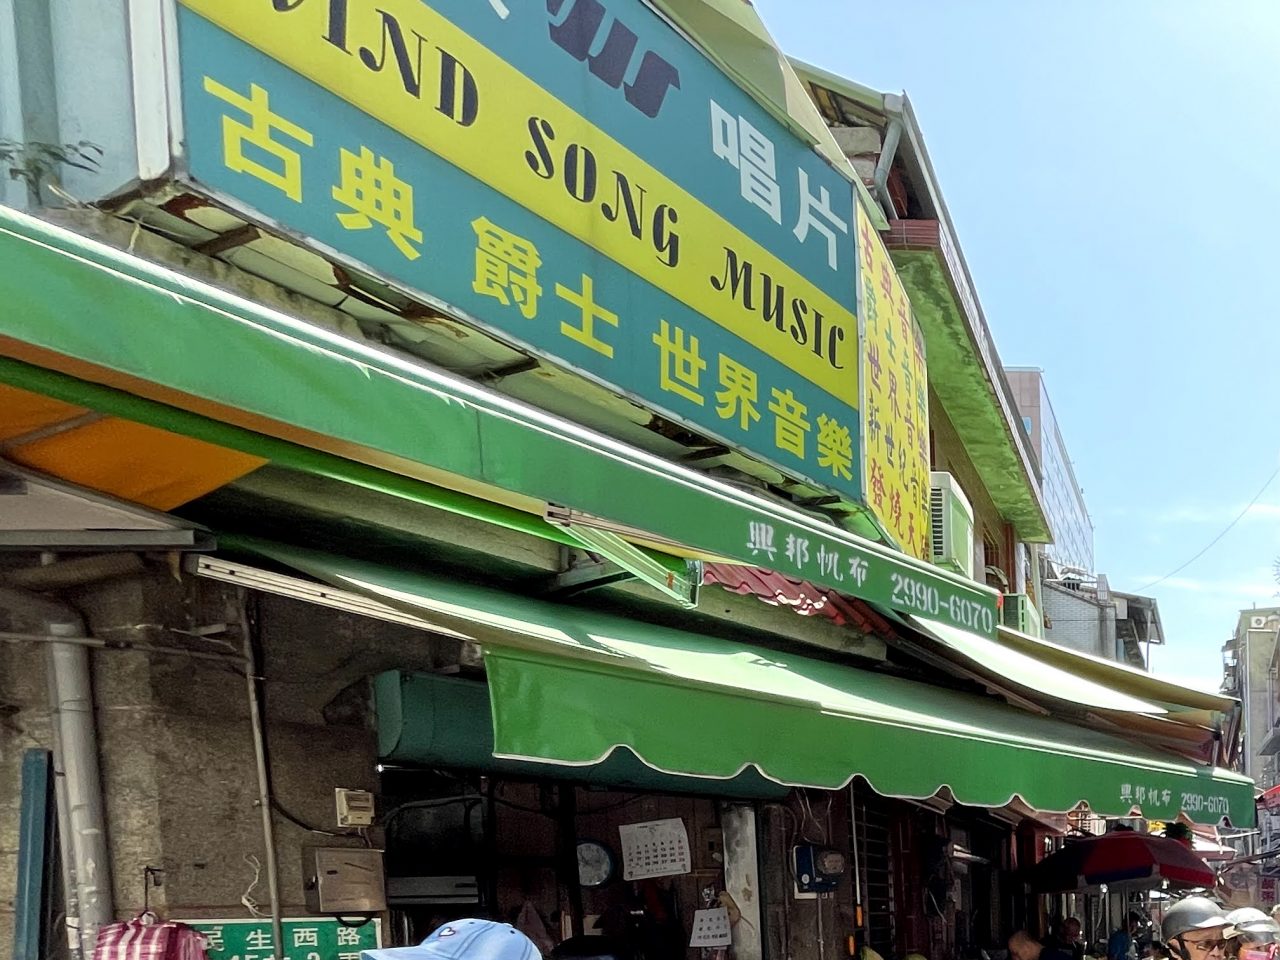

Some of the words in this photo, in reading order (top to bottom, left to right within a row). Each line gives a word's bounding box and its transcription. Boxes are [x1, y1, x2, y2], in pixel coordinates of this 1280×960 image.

[272, 0, 479, 127] IND
[524, 116, 680, 268] SONG
[710, 247, 845, 369] MUSIC
[710, 98, 848, 272] 唱片
[203, 75, 424, 261] 古典
[470, 216, 620, 359] 爵士
[652, 319, 853, 481] 世界音樂
[746, 521, 869, 588] 興邦帆布
[891, 571, 993, 634] 2990-6070
[1120, 784, 1172, 807] 興邦帆布
[1181, 792, 1230, 814] 2990-6070
[200, 926, 361, 952] 民生西路
